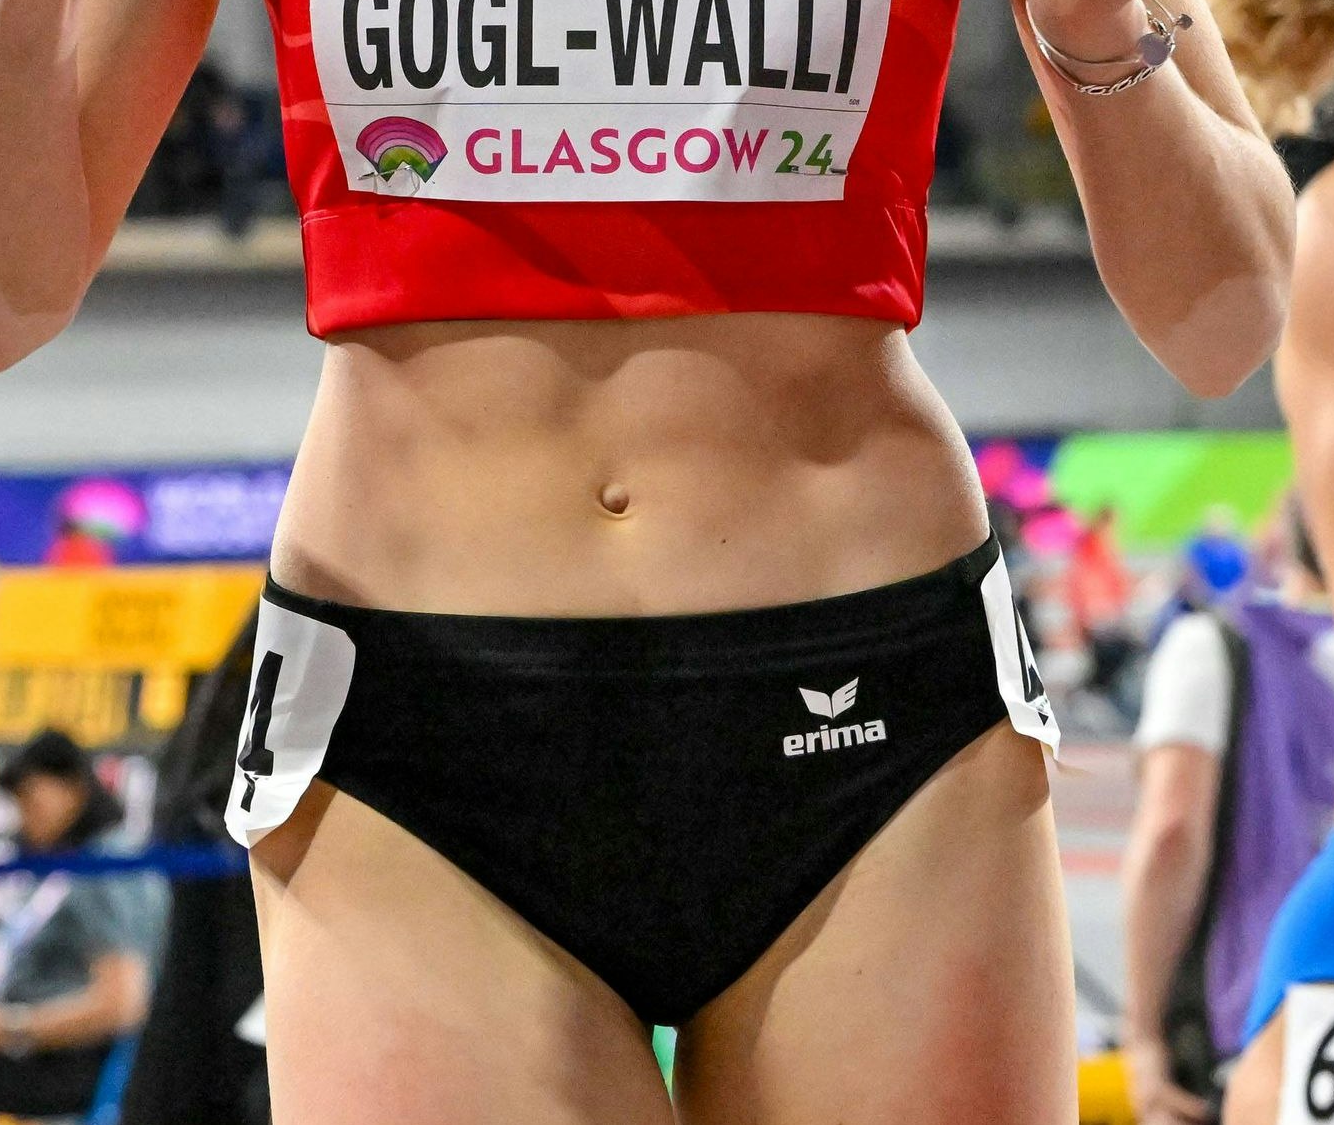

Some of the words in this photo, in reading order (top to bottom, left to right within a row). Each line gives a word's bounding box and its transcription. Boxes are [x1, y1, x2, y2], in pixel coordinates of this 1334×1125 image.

[465, 127, 770, 175] GLASGOW
[774, 129, 834, 176] 24
[783, 719, 887, 757] erima
